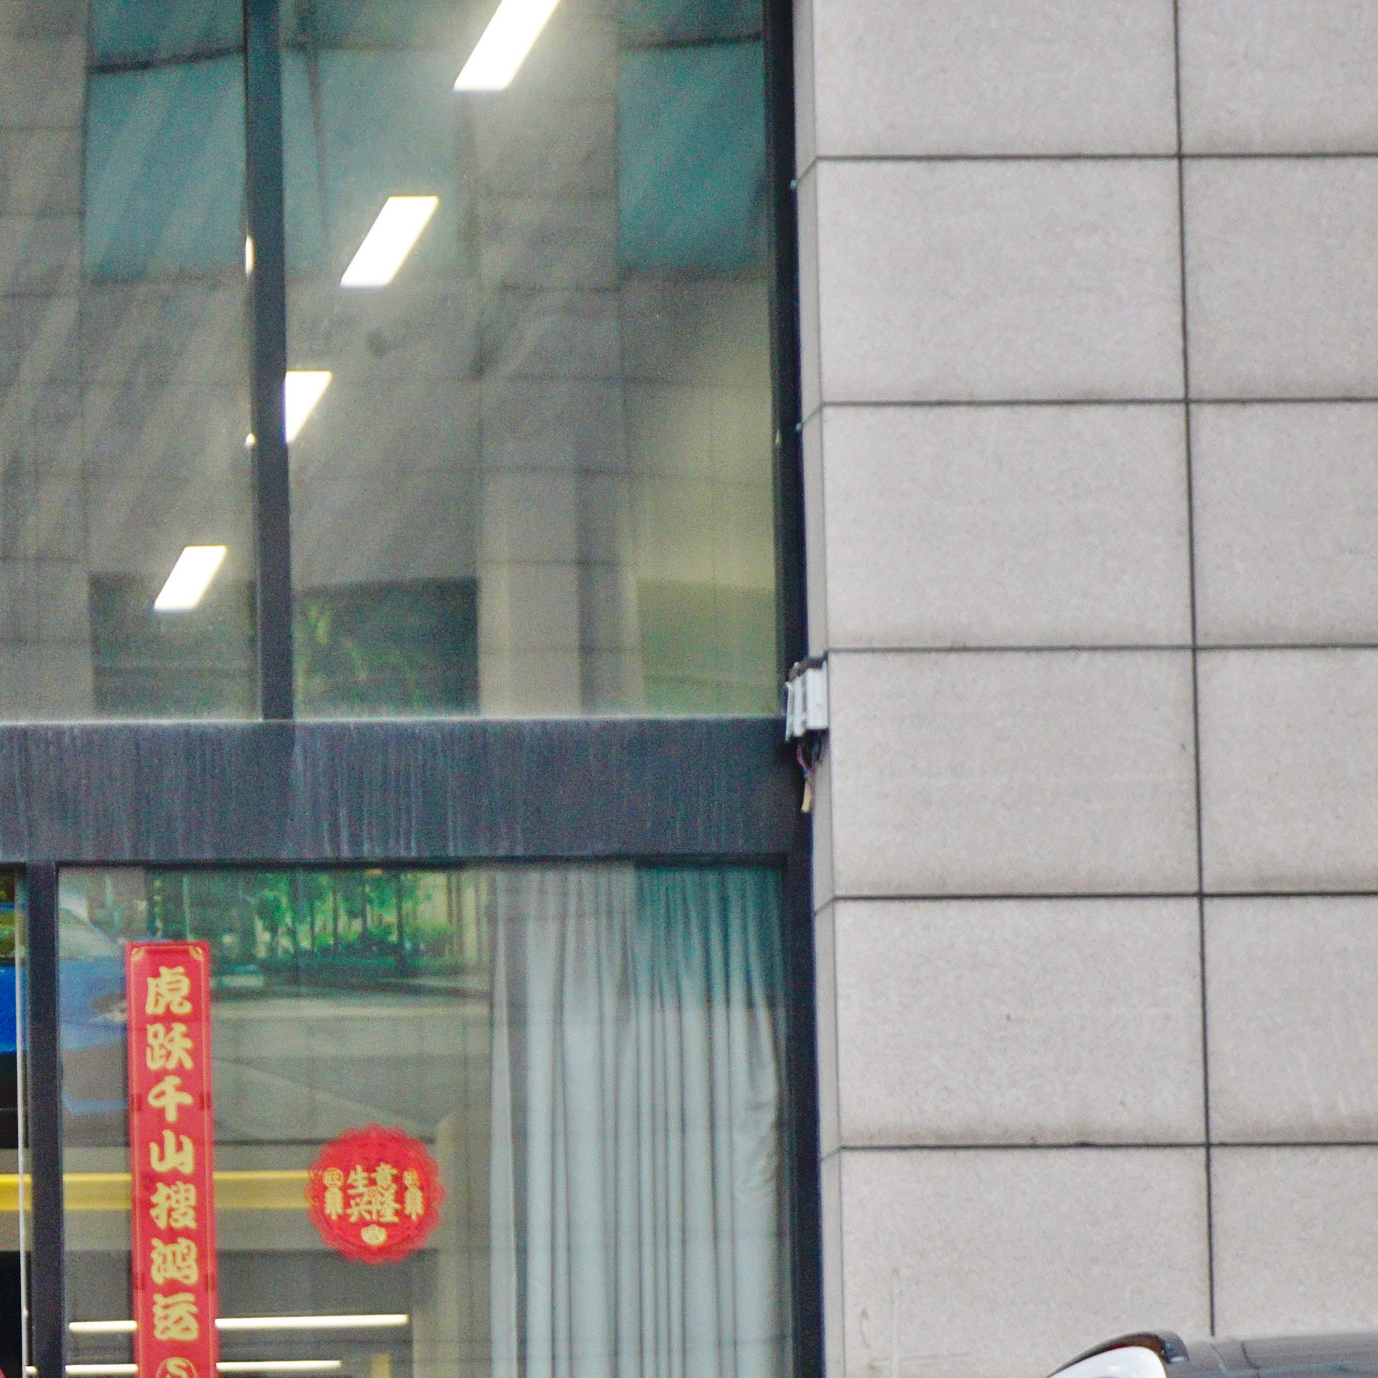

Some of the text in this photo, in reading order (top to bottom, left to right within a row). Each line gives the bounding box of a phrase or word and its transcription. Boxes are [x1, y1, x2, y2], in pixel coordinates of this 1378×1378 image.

[145, 965, 200, 1342] 虎跃千山搜鸿运
